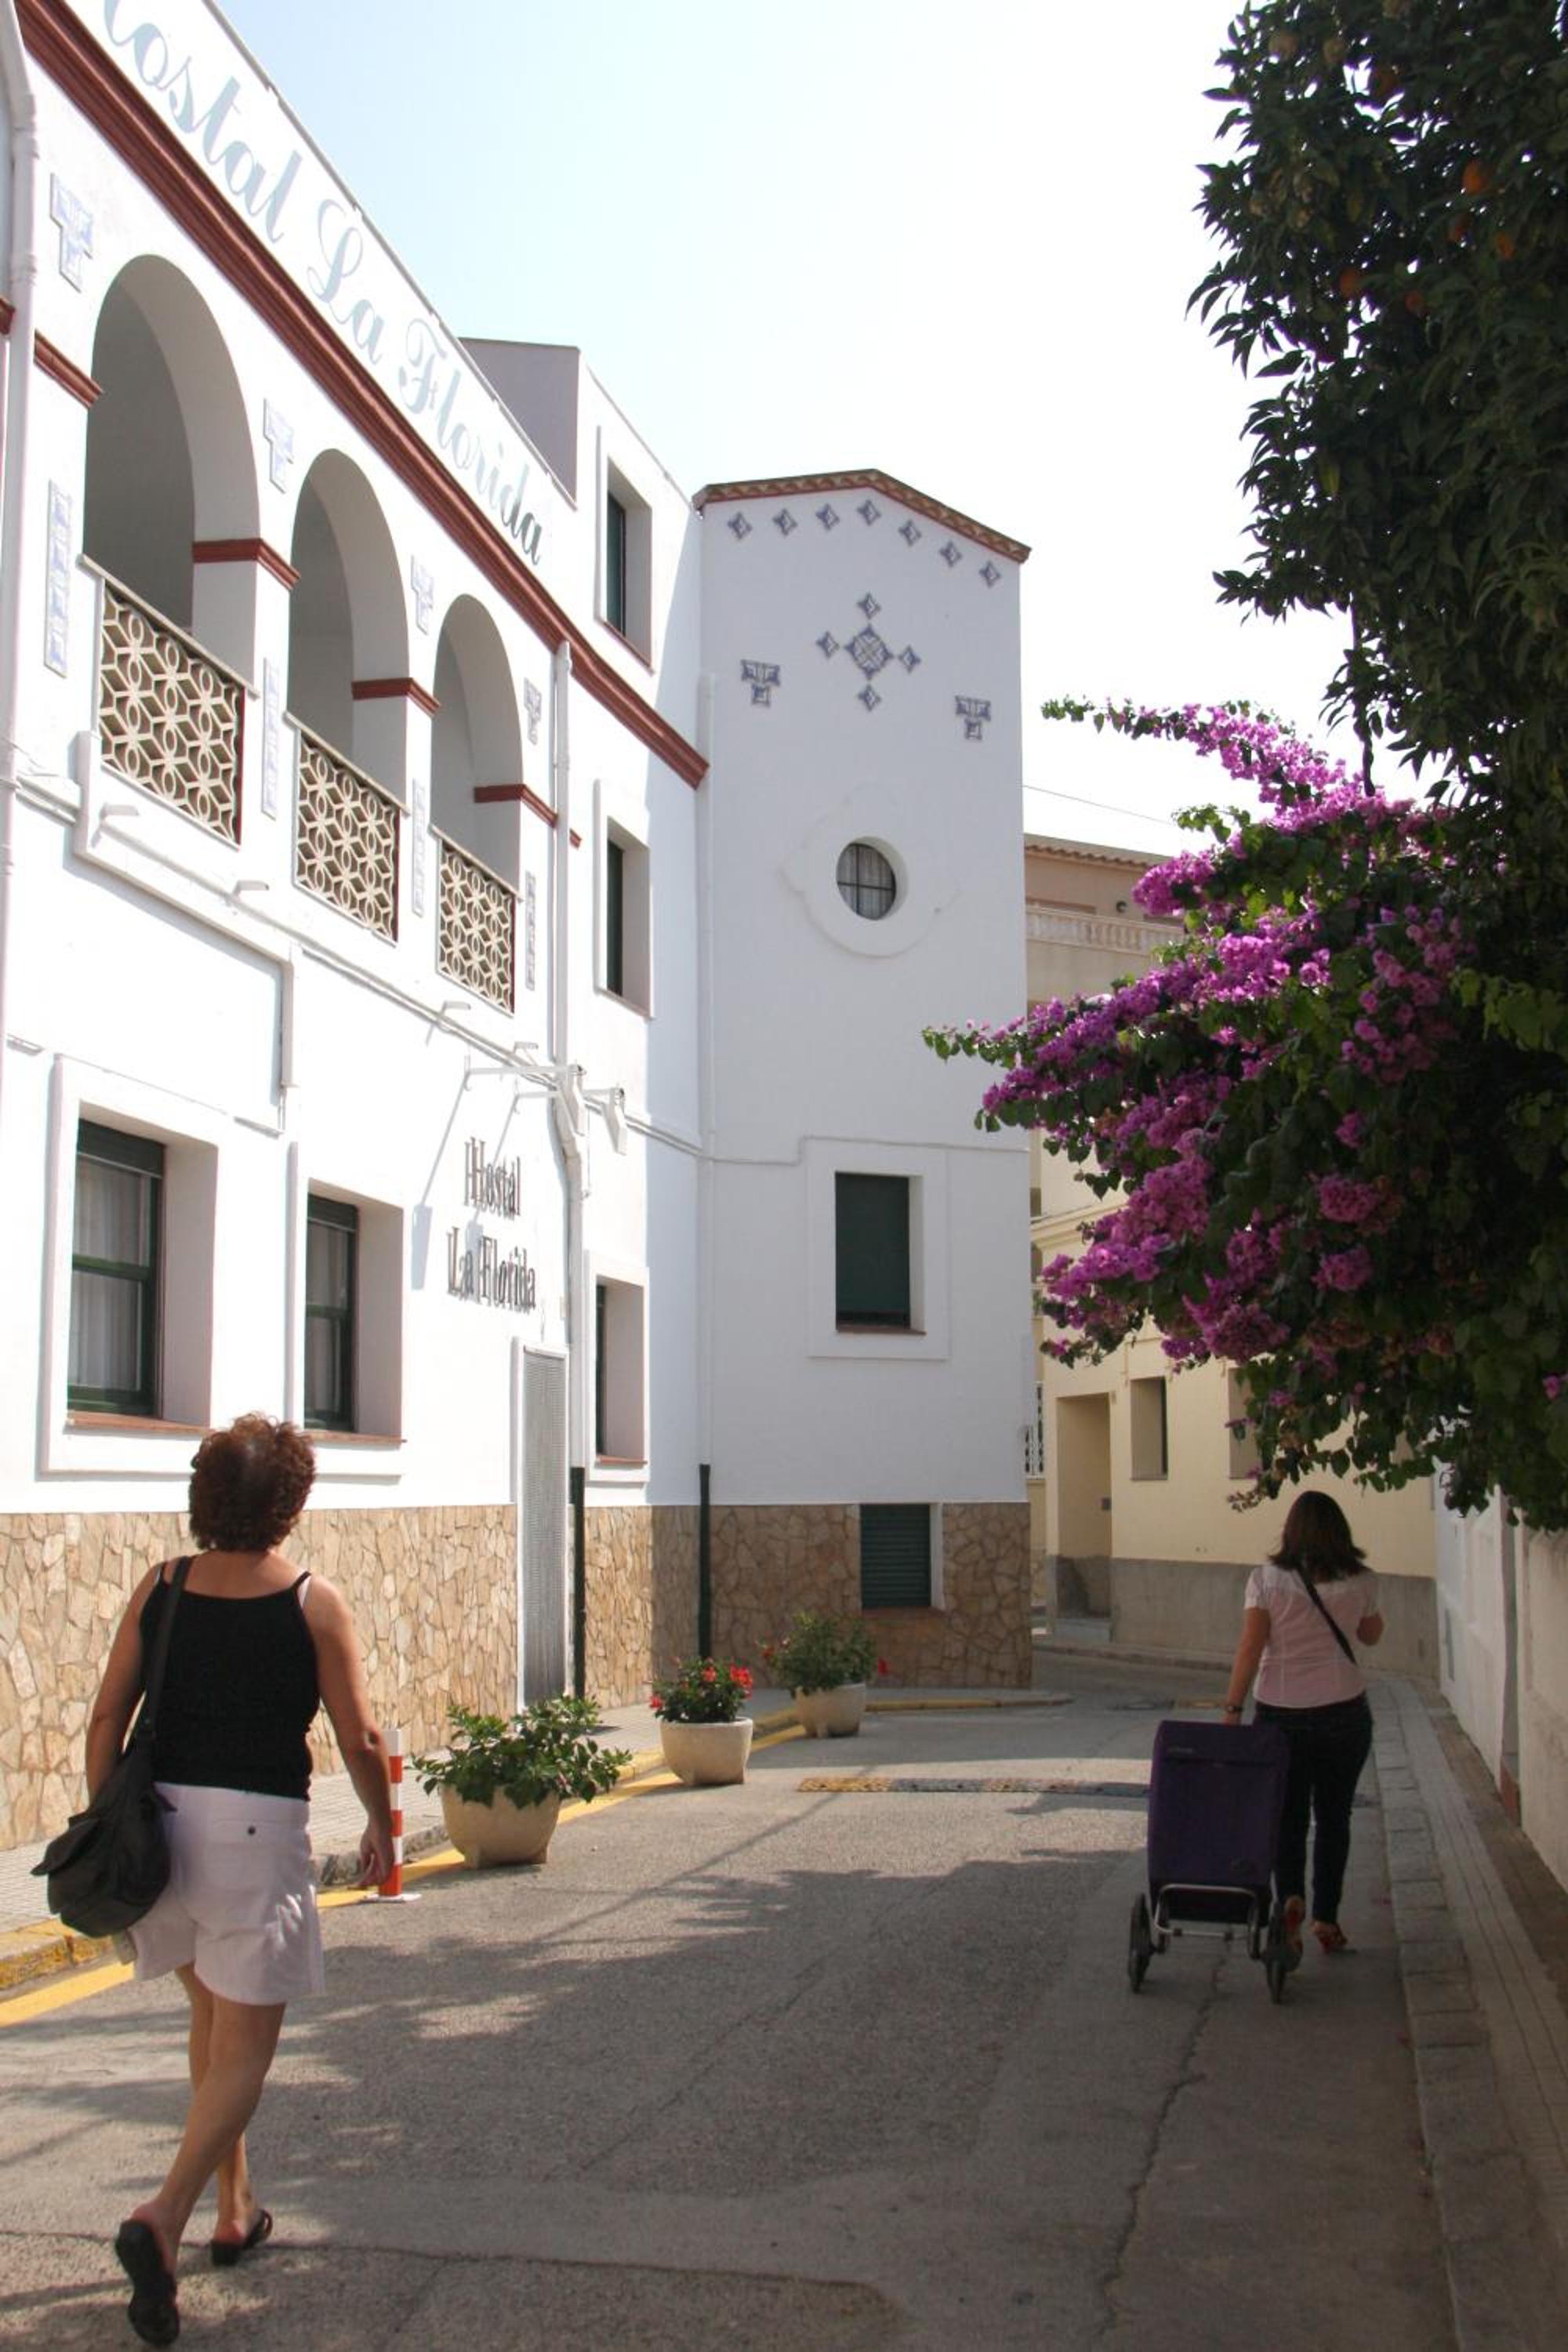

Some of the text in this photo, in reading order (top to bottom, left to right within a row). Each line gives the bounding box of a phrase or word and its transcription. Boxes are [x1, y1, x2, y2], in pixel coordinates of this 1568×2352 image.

[103, 0, 543, 565] ostal La Florida
[470, 1137, 521, 1217] Hostal
[450, 1226, 535, 1310] La Florida
